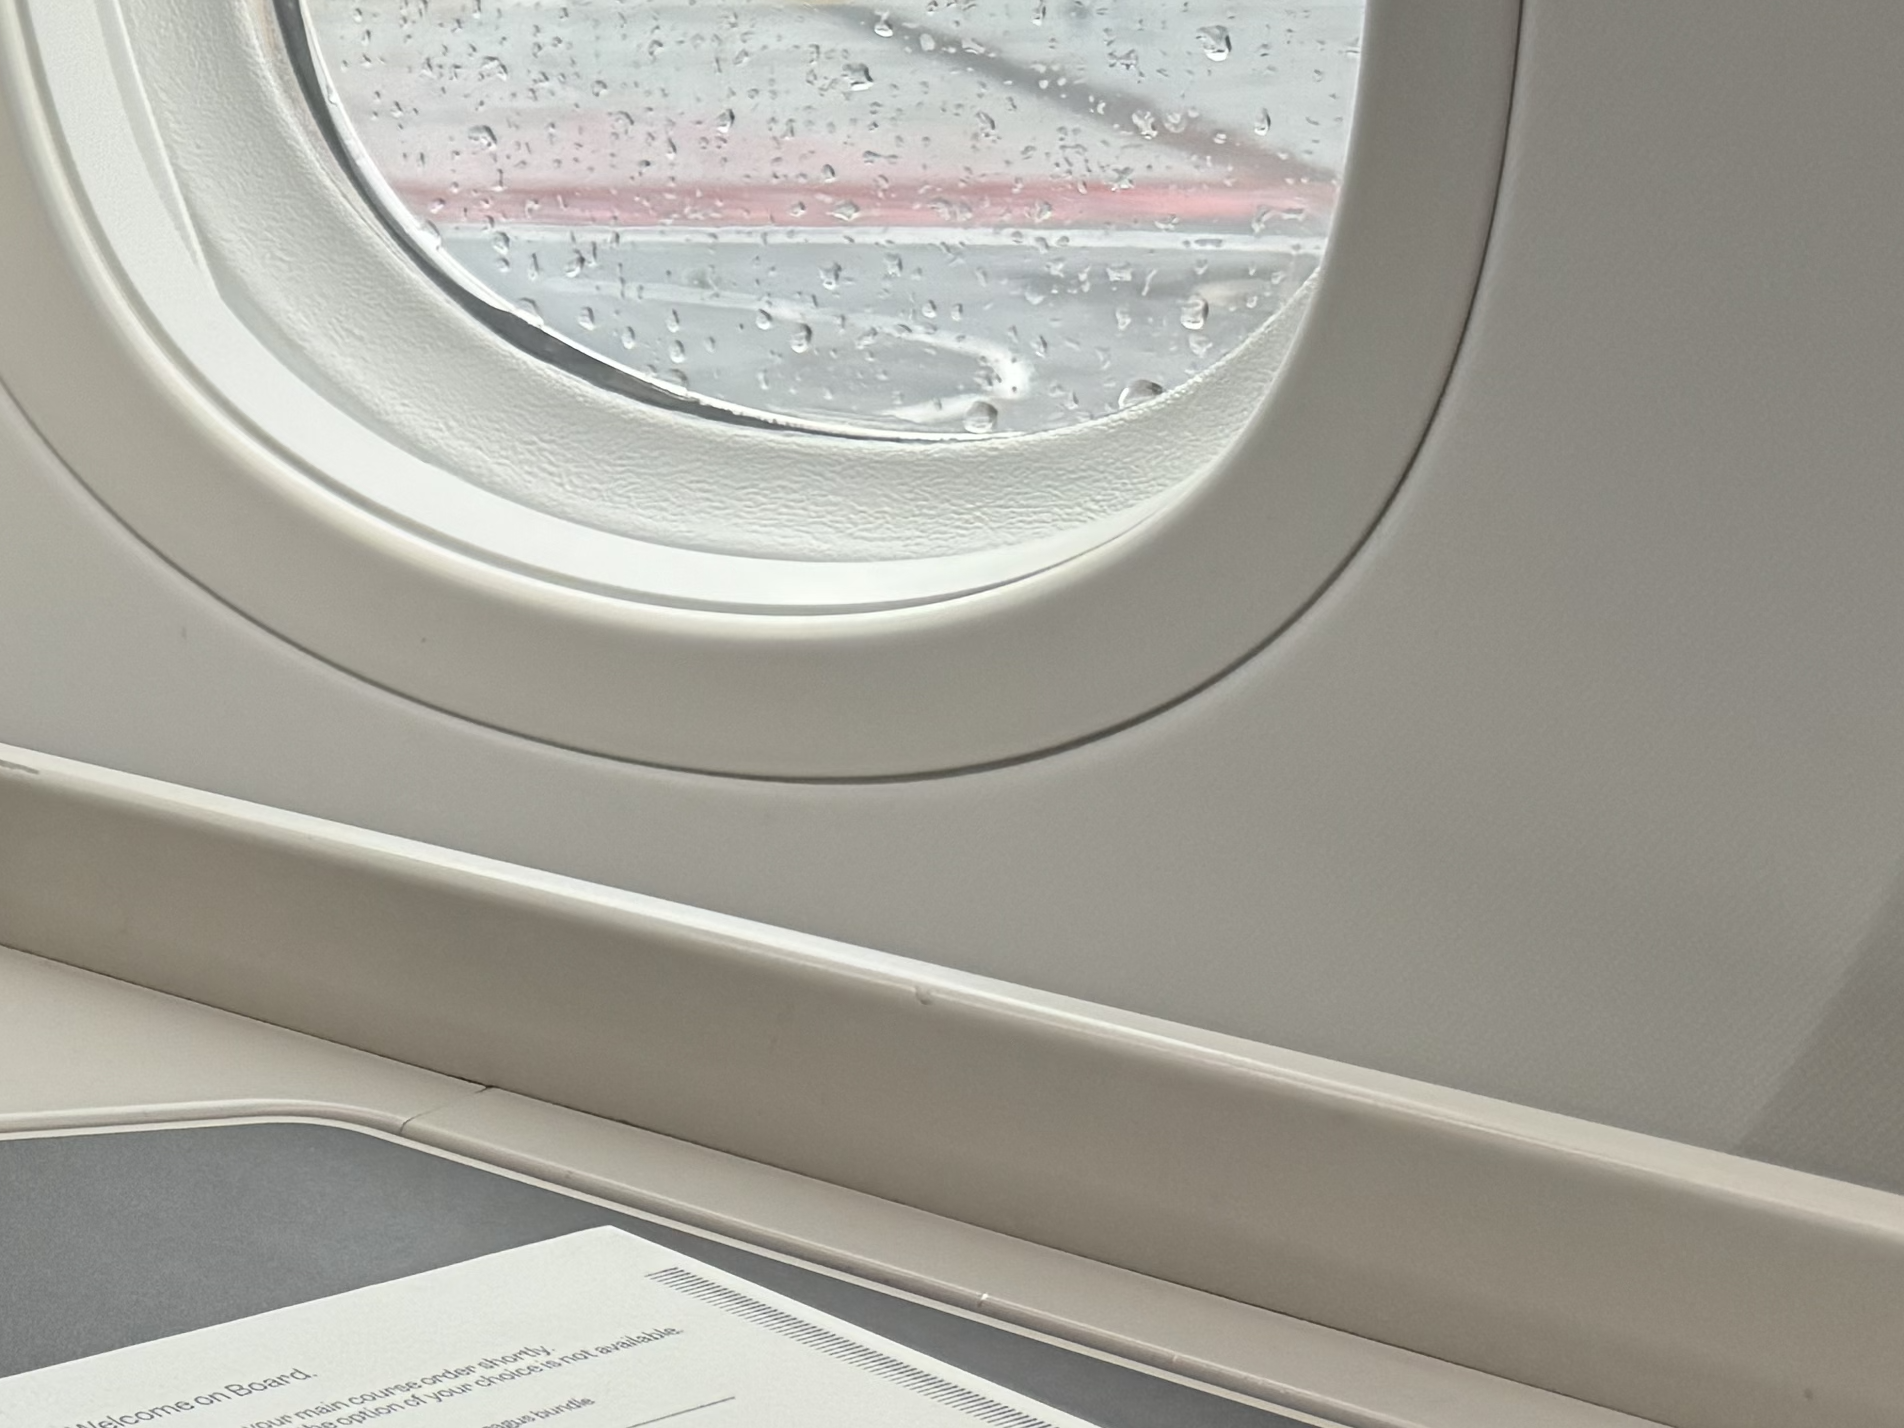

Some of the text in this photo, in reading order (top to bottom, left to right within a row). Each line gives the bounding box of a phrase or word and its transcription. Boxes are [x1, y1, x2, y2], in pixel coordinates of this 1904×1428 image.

[192, 1391, 232, 1406] on
[292, 1400, 350, 1420] main
[347, 1380, 423, 1405] course
[419, 1364, 476, 1386] order
[334, 1402, 406, 1426] option
[402, 1392, 428, 1407] of
[422, 1382, 473, 1403] your
[473, 1363, 544, 1387] choice
[533, 1359, 562, 1369] is
[557, 1348, 599, 1365] not
